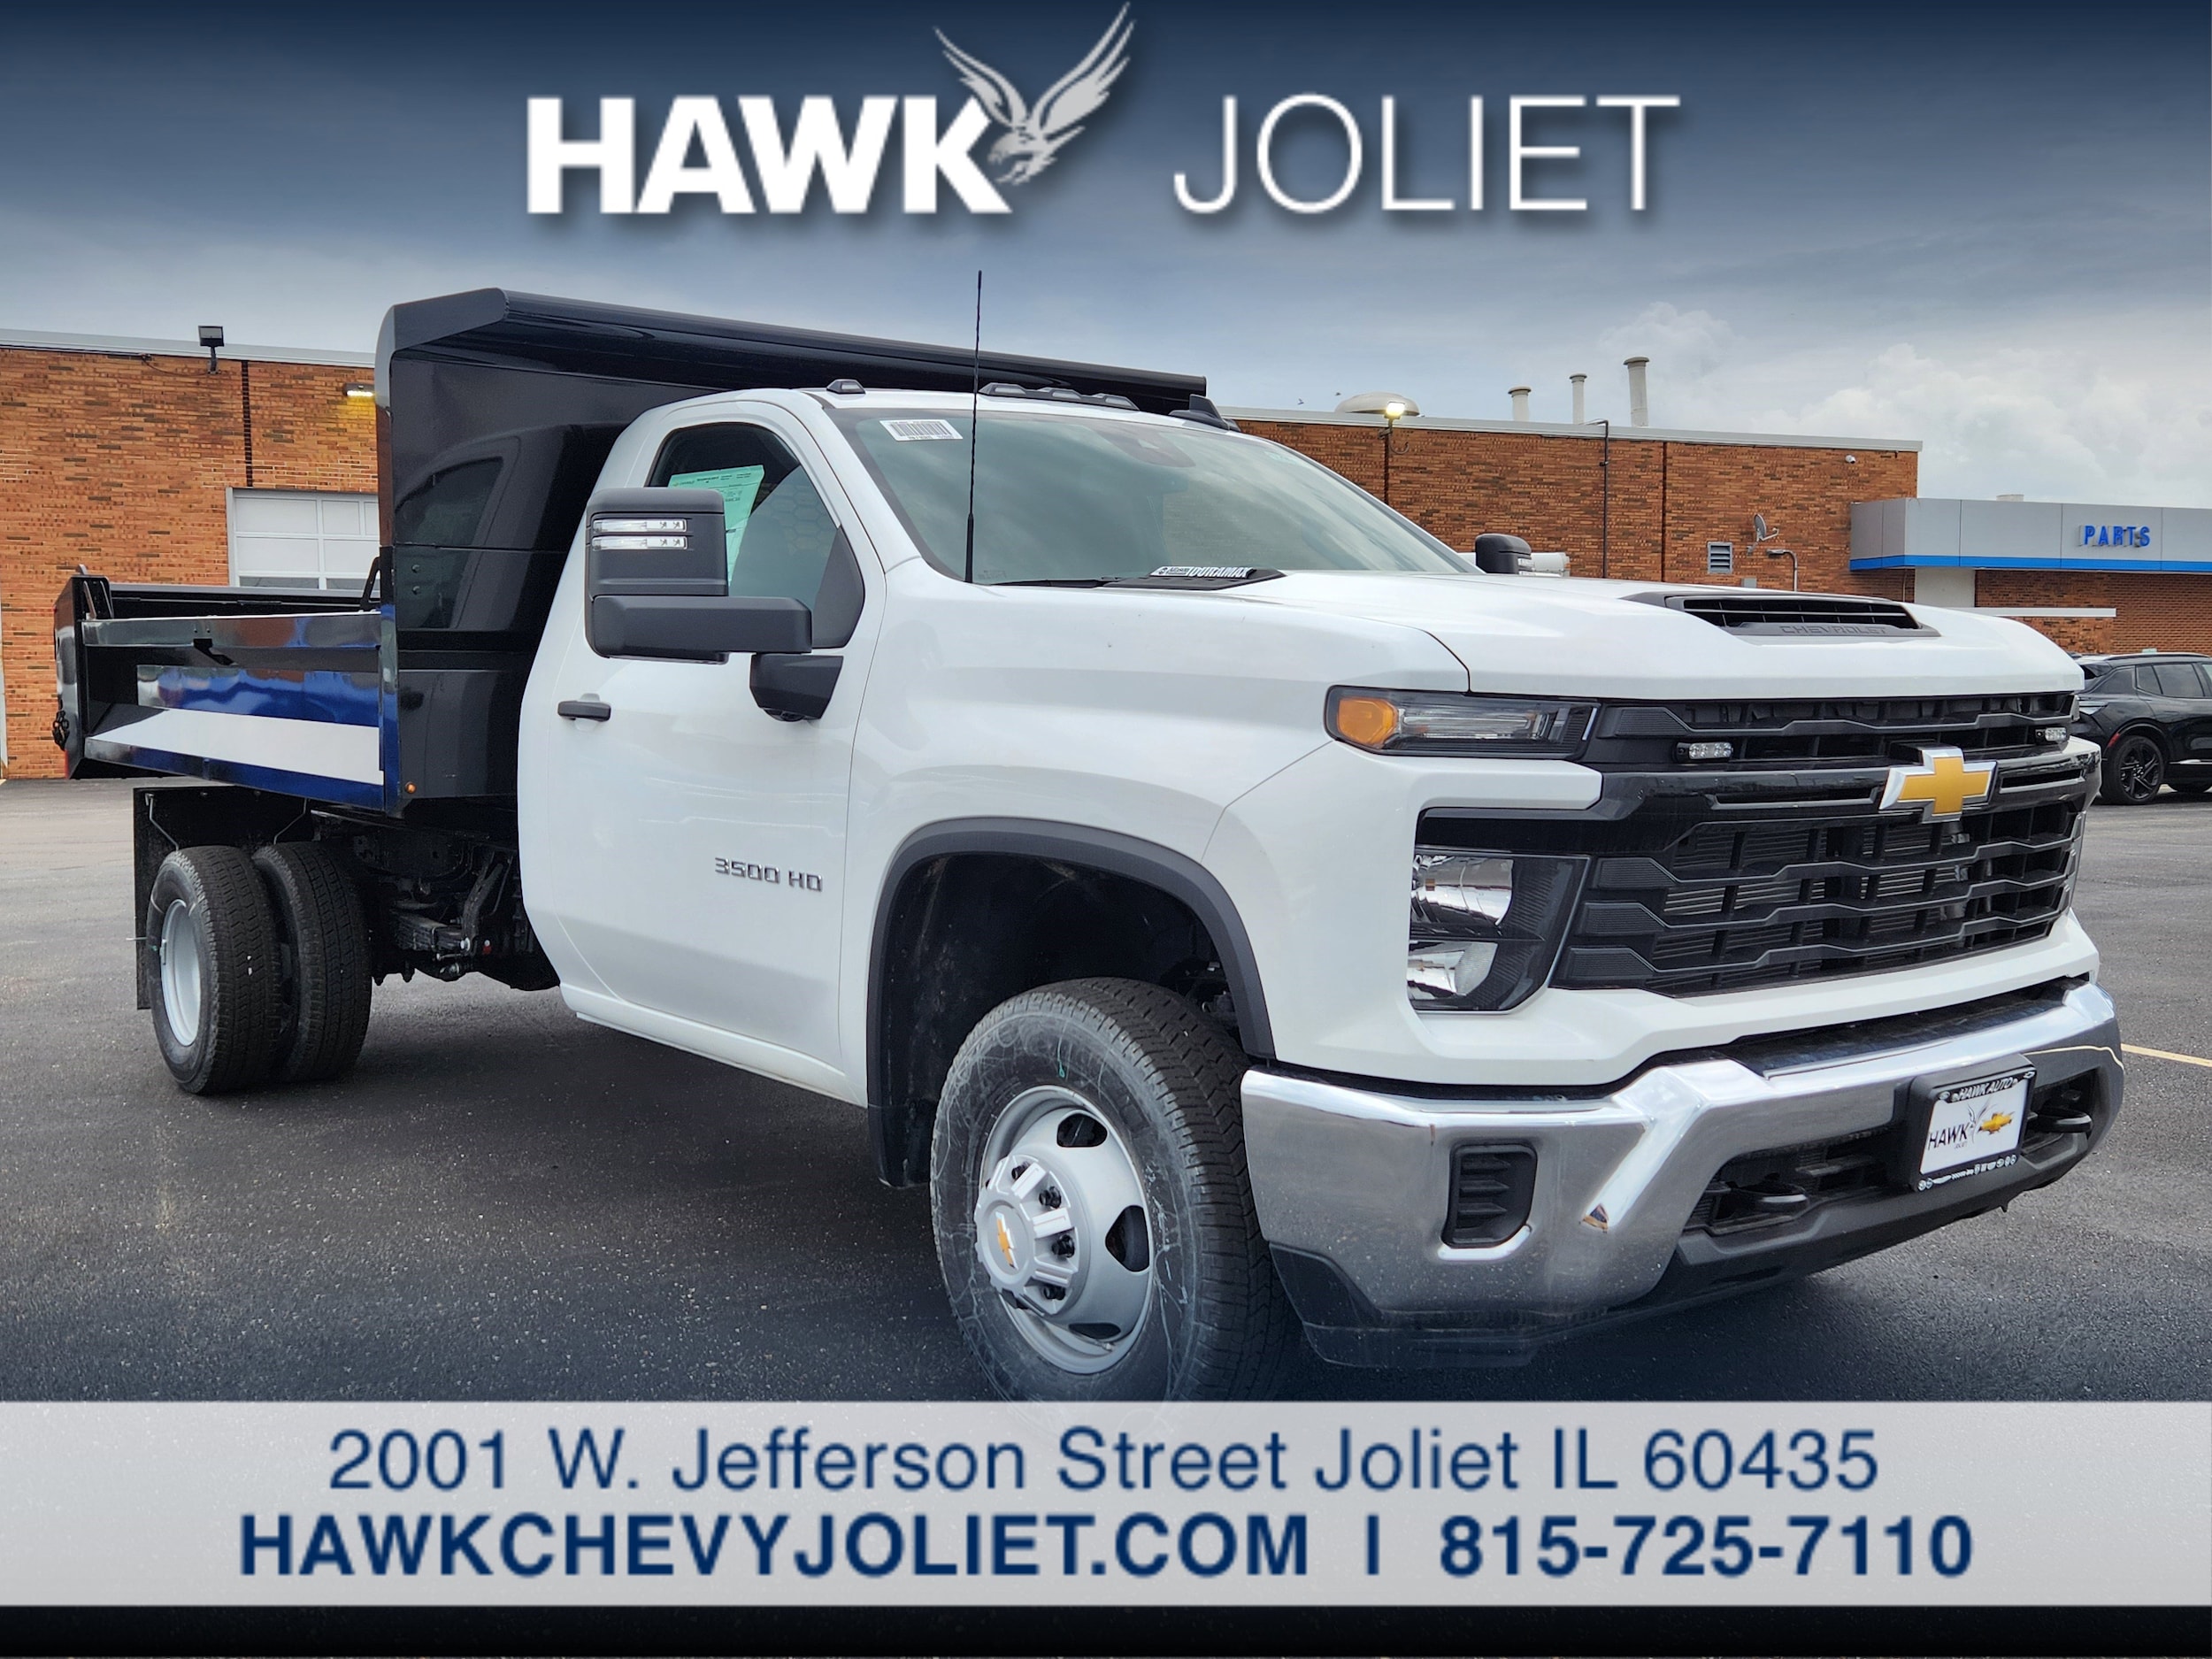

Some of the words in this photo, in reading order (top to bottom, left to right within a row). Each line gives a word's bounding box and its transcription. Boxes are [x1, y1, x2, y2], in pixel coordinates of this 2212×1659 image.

[2084, 525, 2150, 547] PARTS
[1188, 566, 1252, 578] DURAMAX
[1778, 626, 1886, 634] CHEVROLET
[715, 856, 780, 885] 3500
[788, 870, 823, 892] HD
[1957, 1084, 1987, 1101] HAWK
[1985, 1076, 2014, 1094] AUTO
[1928, 1122, 1970, 1150] HAWK
